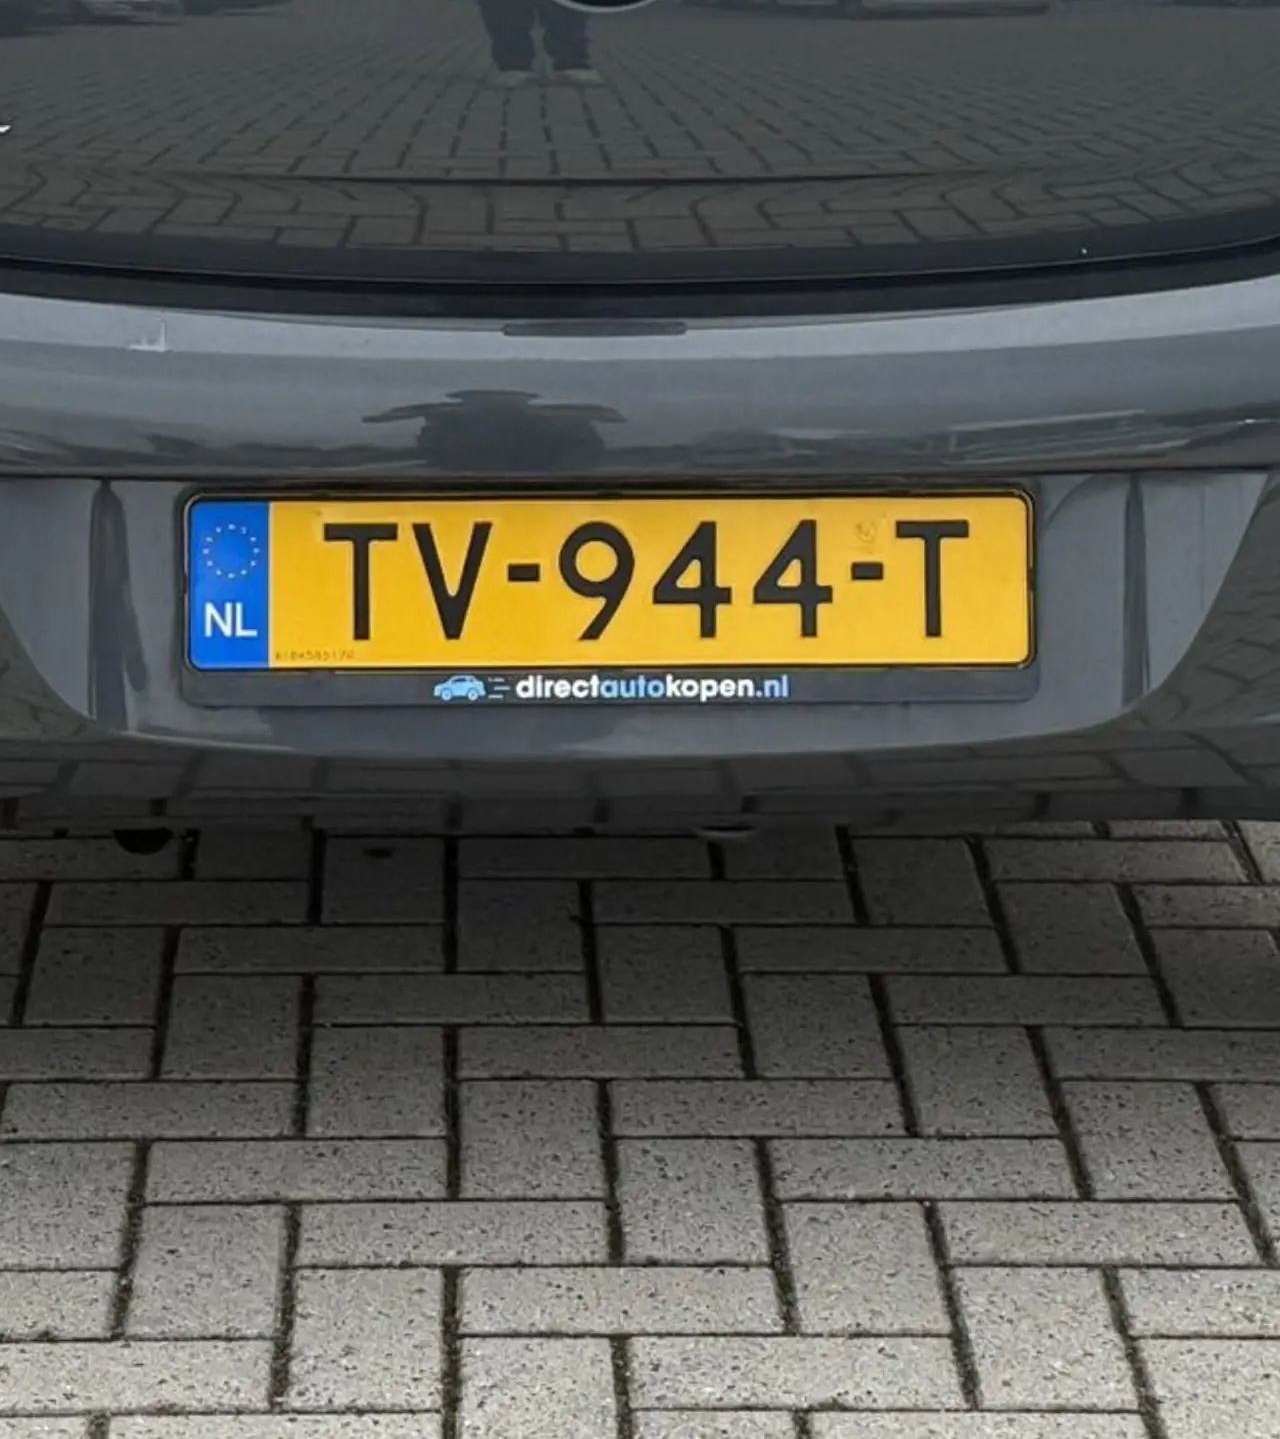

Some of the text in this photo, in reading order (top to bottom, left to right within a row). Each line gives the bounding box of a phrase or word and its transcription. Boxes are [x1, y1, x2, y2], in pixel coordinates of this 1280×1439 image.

[323, 519, 971, 641] TV-944-T
[204, 601, 258, 638] NL
[516, 674, 789, 702] directautokopen.nl
